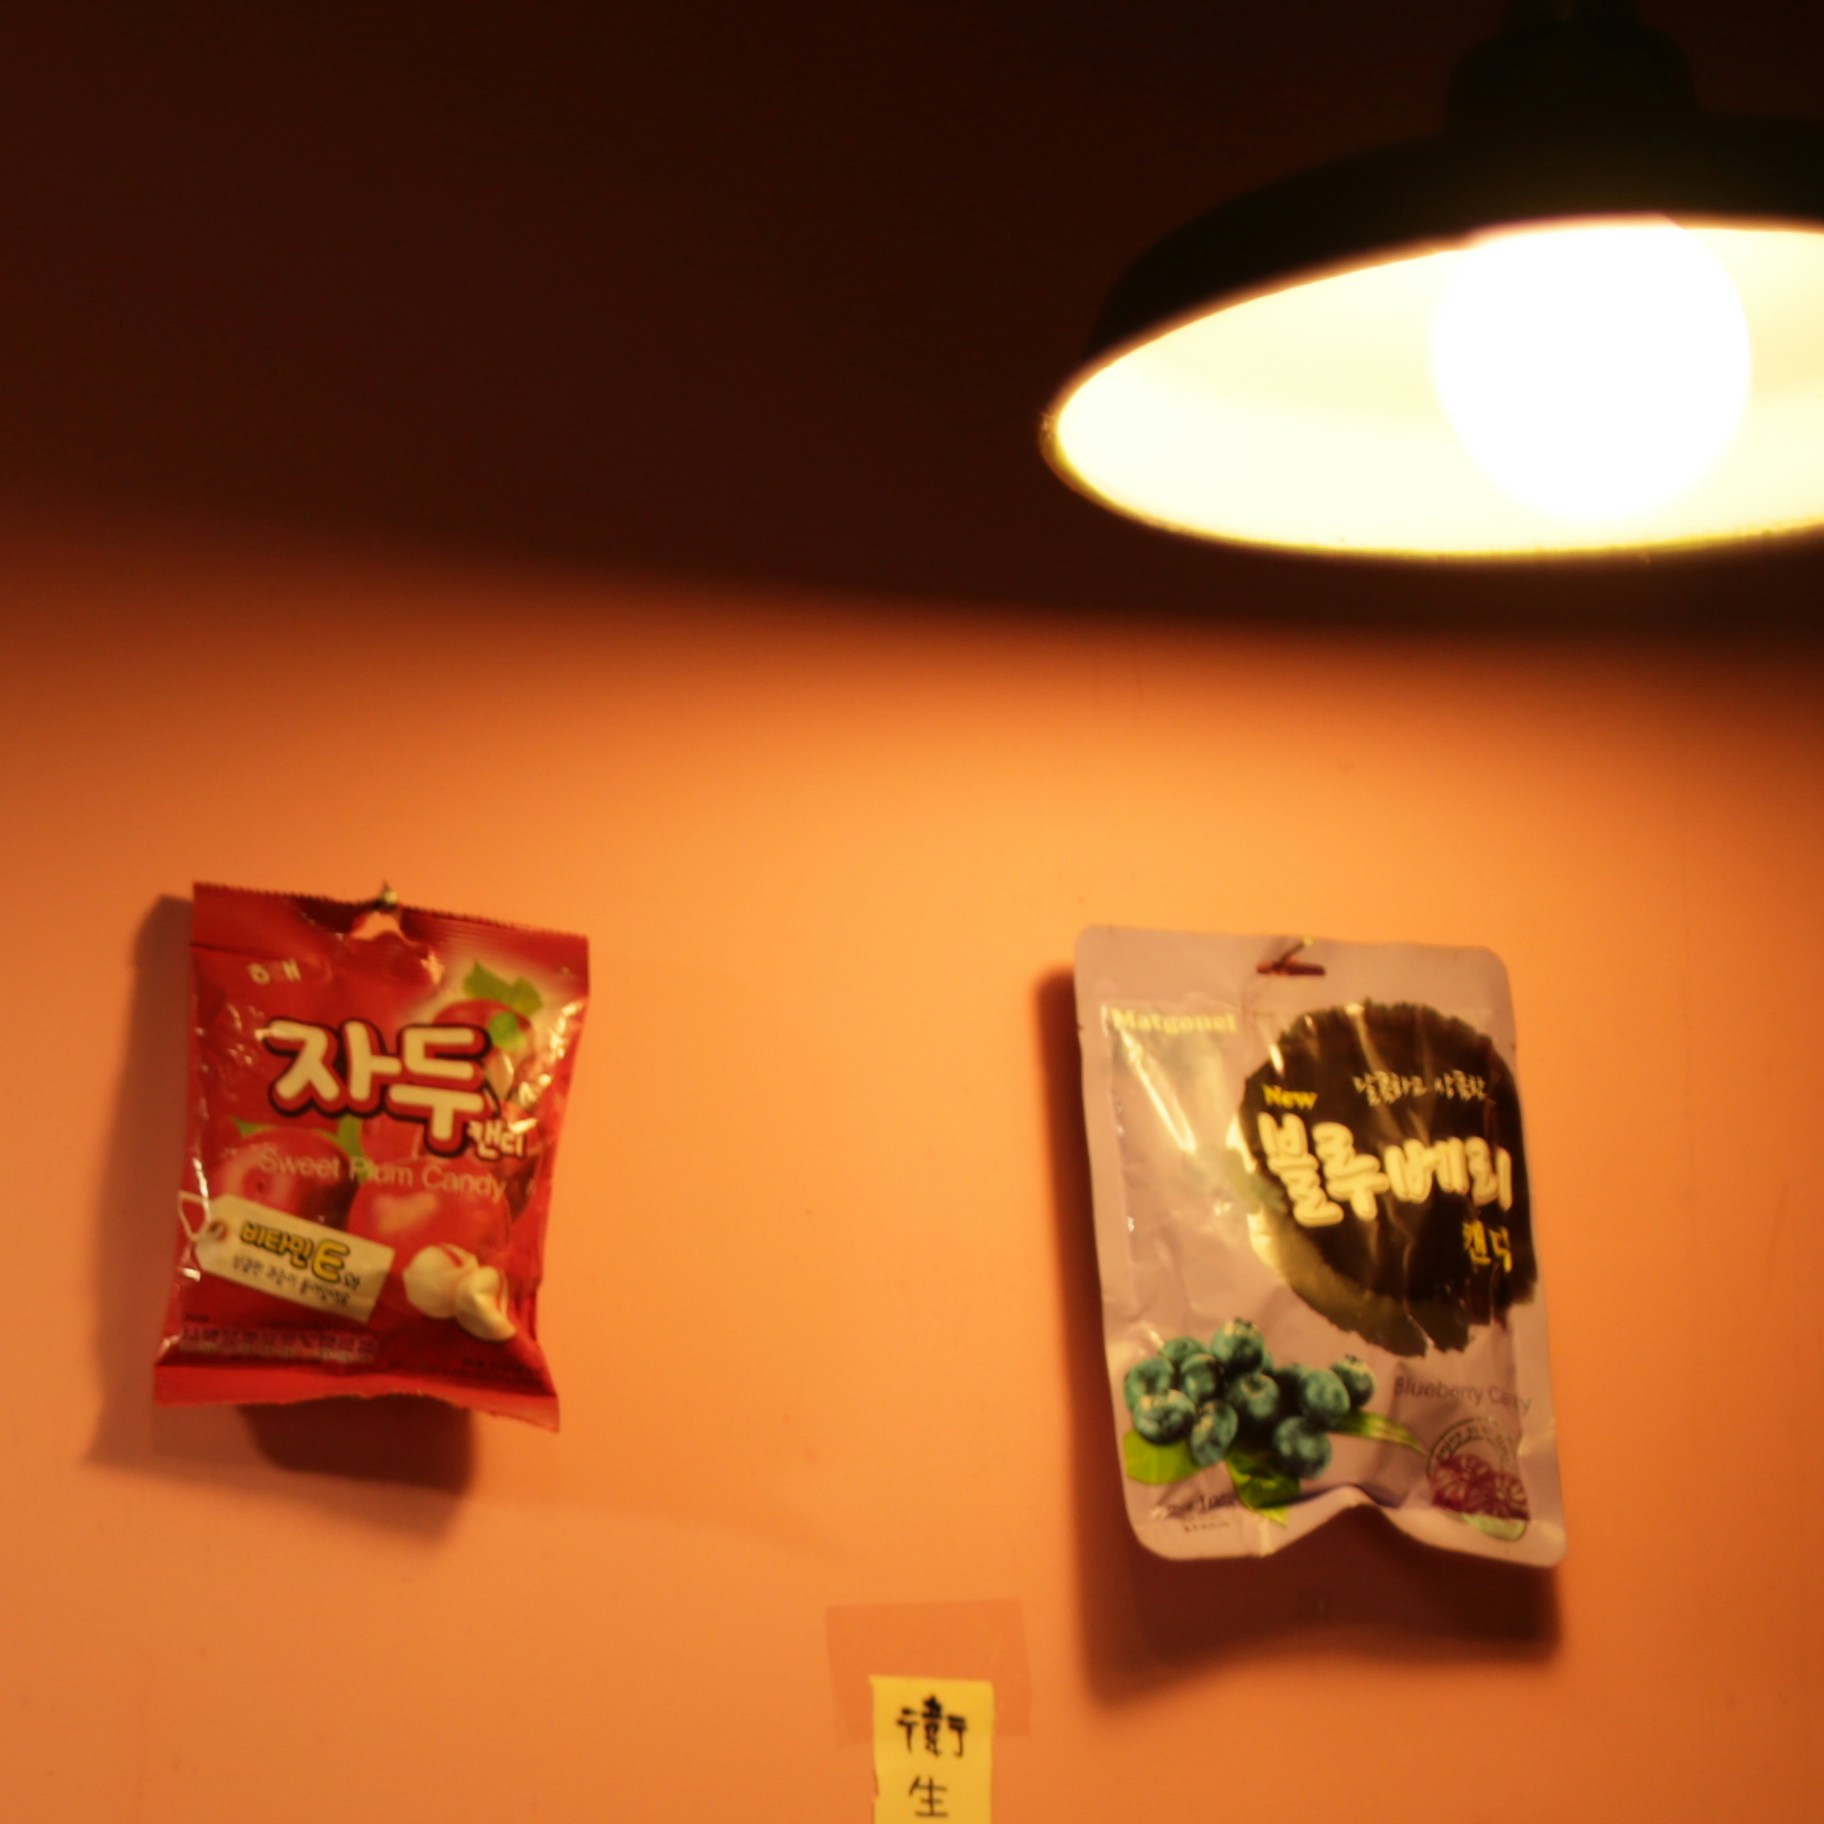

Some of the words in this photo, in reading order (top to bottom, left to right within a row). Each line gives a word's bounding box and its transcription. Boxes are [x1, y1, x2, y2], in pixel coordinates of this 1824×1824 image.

[264, 1020, 487, 1143] 자두
[1261, 1083, 1319, 1110] New
[467, 1119, 524, 1161] 캔디
[1256, 1110, 1515, 1228] 블루베리
[257, 1144, 341, 1180] Sweet
[349, 1155, 414, 1187] Plum
[421, 1164, 508, 1203] Candy
[1462, 1218, 1514, 1276] 캔디
[1393, 1375, 1483, 1407] Blueberry
